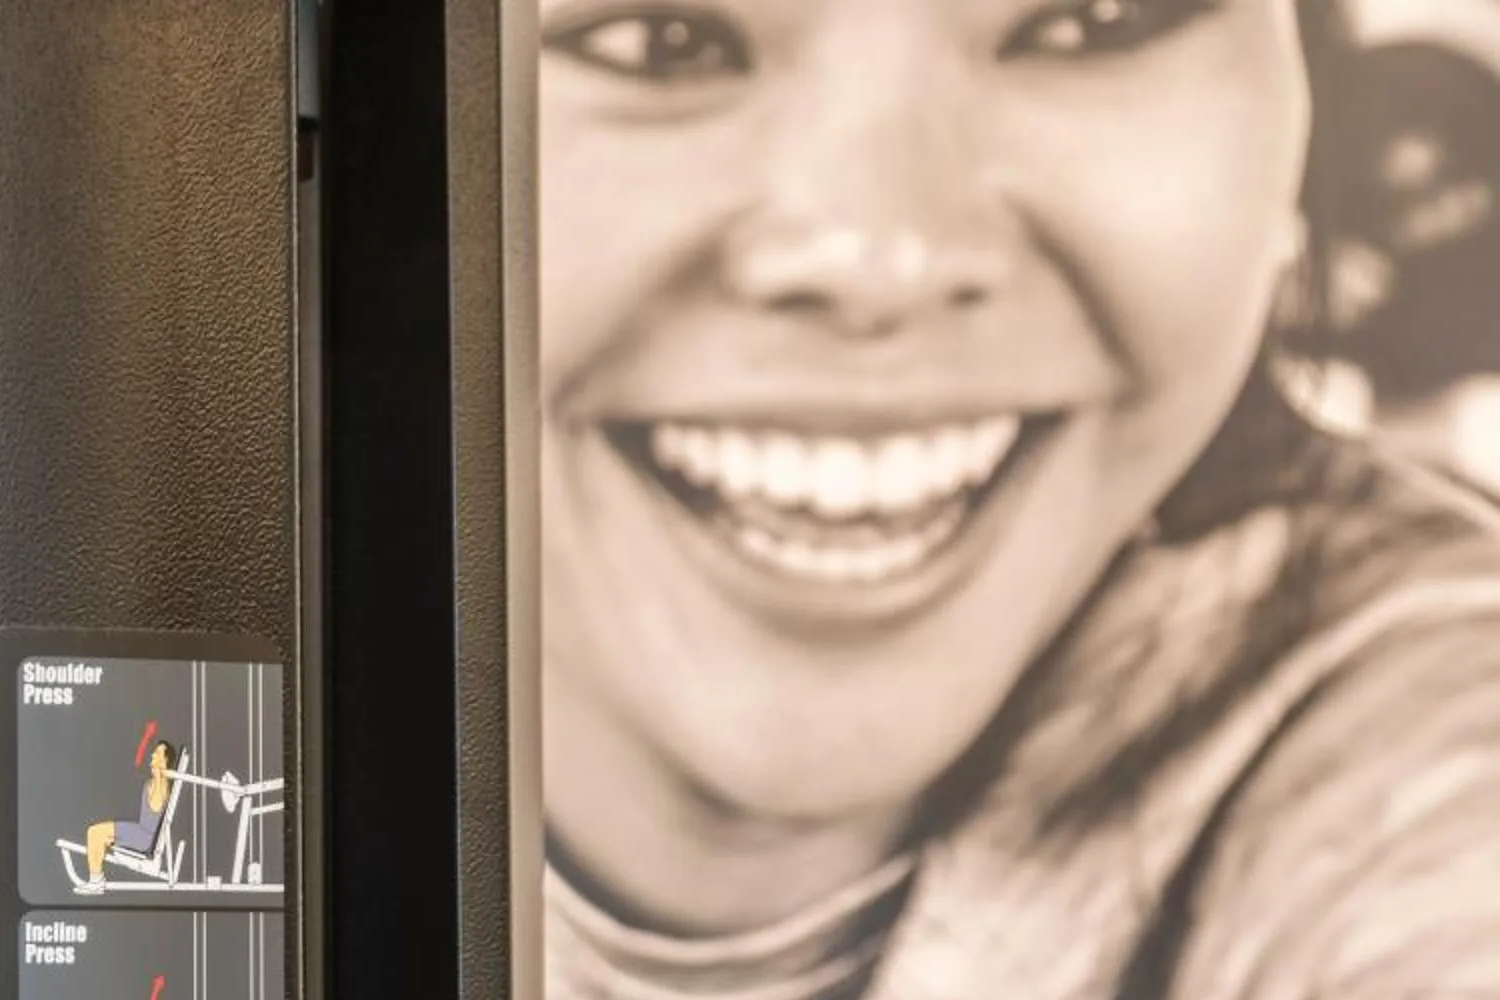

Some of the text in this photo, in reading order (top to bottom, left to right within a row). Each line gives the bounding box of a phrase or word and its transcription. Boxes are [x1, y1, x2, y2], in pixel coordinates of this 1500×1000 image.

[22, 661, 104, 687] Shoulder
[23, 684, 75, 706] Press
[24, 921, 88, 944] Incline
[24, 943, 77, 966] Press
